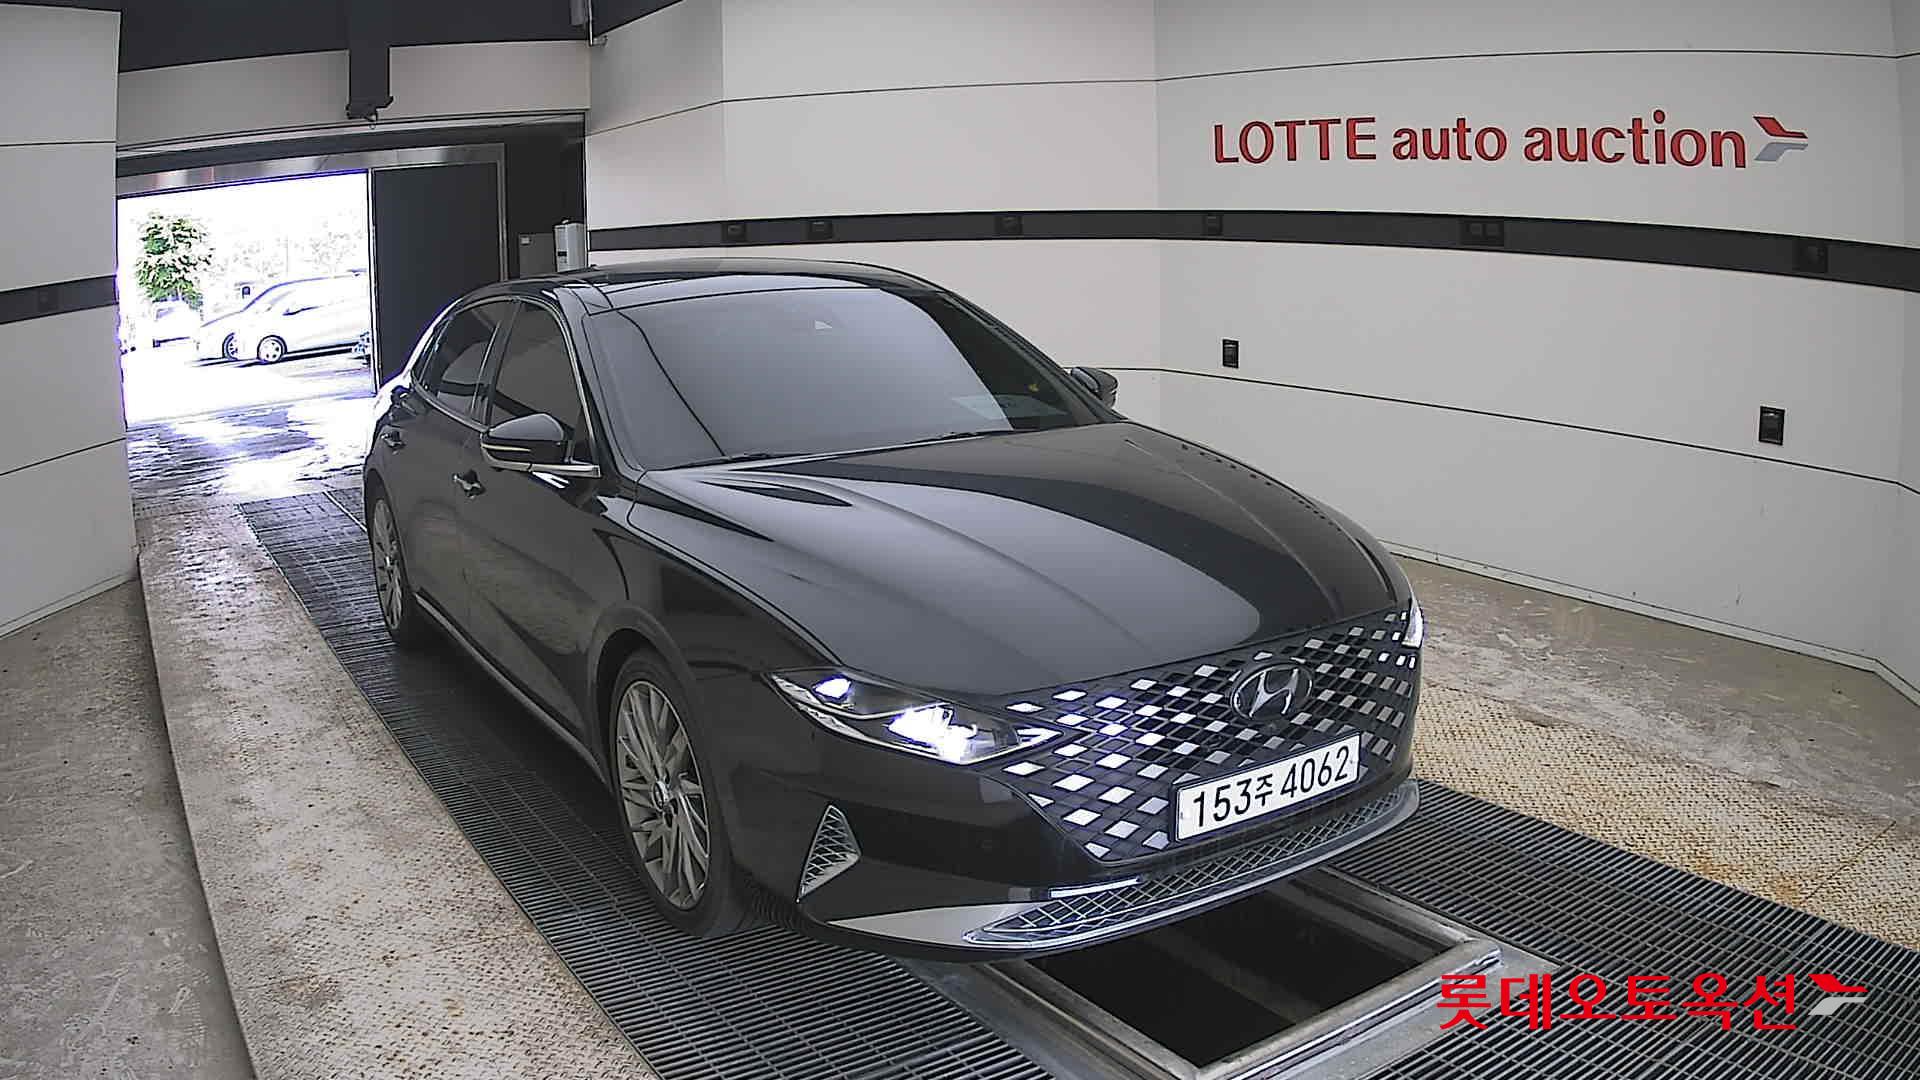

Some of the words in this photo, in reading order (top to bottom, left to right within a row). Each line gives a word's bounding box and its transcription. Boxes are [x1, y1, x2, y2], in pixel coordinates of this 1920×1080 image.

[1213, 116, 1377, 164] LOTTE
[1392, 117, 1508, 162] auto
[1523, 109, 1748, 169] auction
[1192, 773, 1274, 828] 153주
[1280, 745, 1350, 798] 4062
